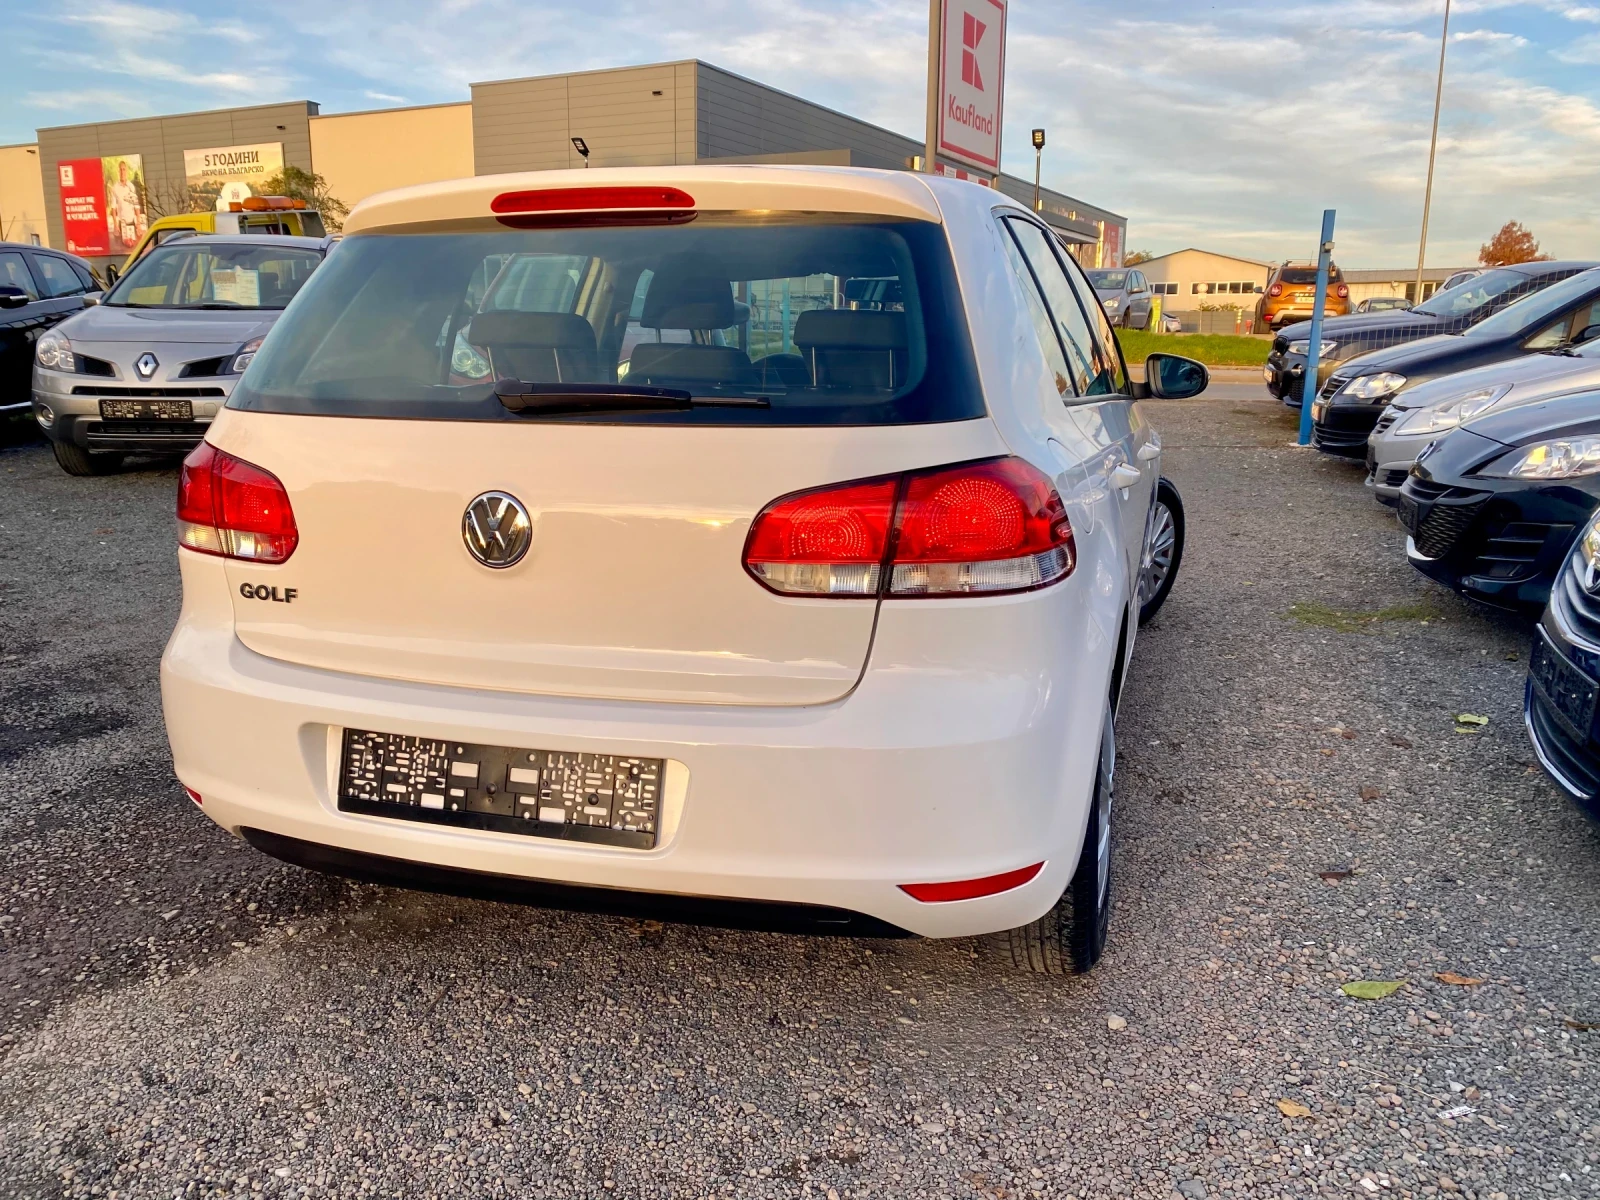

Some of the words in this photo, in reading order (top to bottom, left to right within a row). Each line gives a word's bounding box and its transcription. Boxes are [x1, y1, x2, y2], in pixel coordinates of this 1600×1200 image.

[948, 94, 993, 136] Kaufland
[204, 155, 210, 167] 5
[212, 151, 259, 167] ГОДИНИ
[201, 169, 218, 177] ВКУС
[218, 168, 228, 176] НА
[228, 166, 264, 175] БЪЛГАРСКО
[239, 582, 298, 603] GOLF
